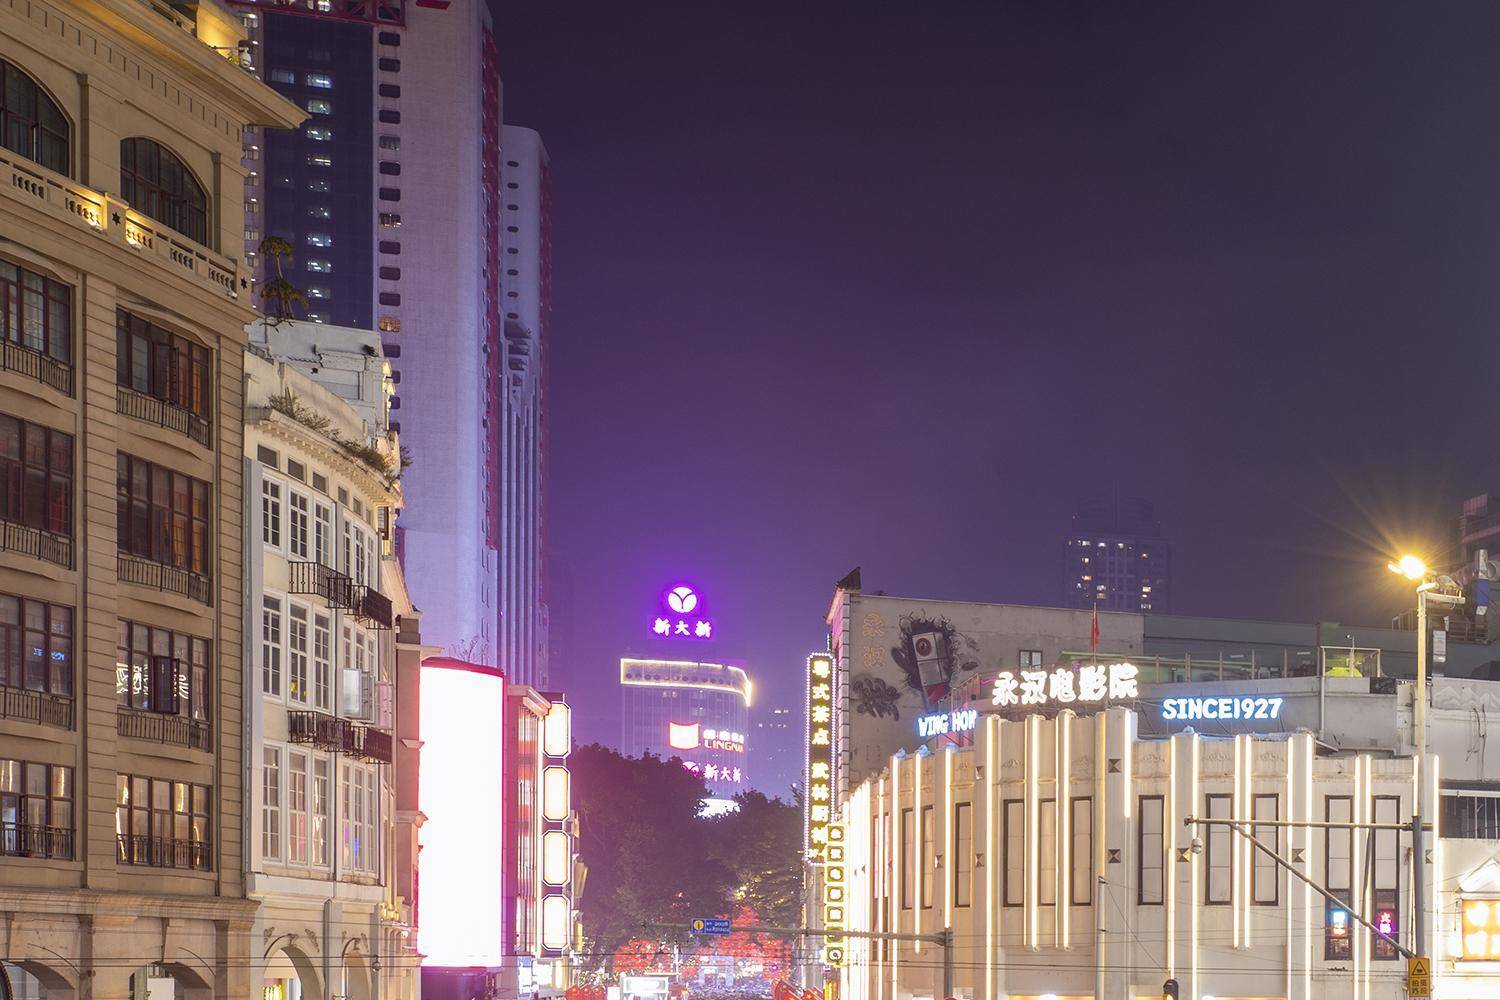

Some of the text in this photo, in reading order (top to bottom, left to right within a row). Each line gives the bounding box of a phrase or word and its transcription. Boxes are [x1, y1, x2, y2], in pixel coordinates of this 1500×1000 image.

[653, 617, 712, 638] 新大新
[992, 663, 1139, 706] 永汉电影院
[1162, 697, 1284, 720] SINCE1927
